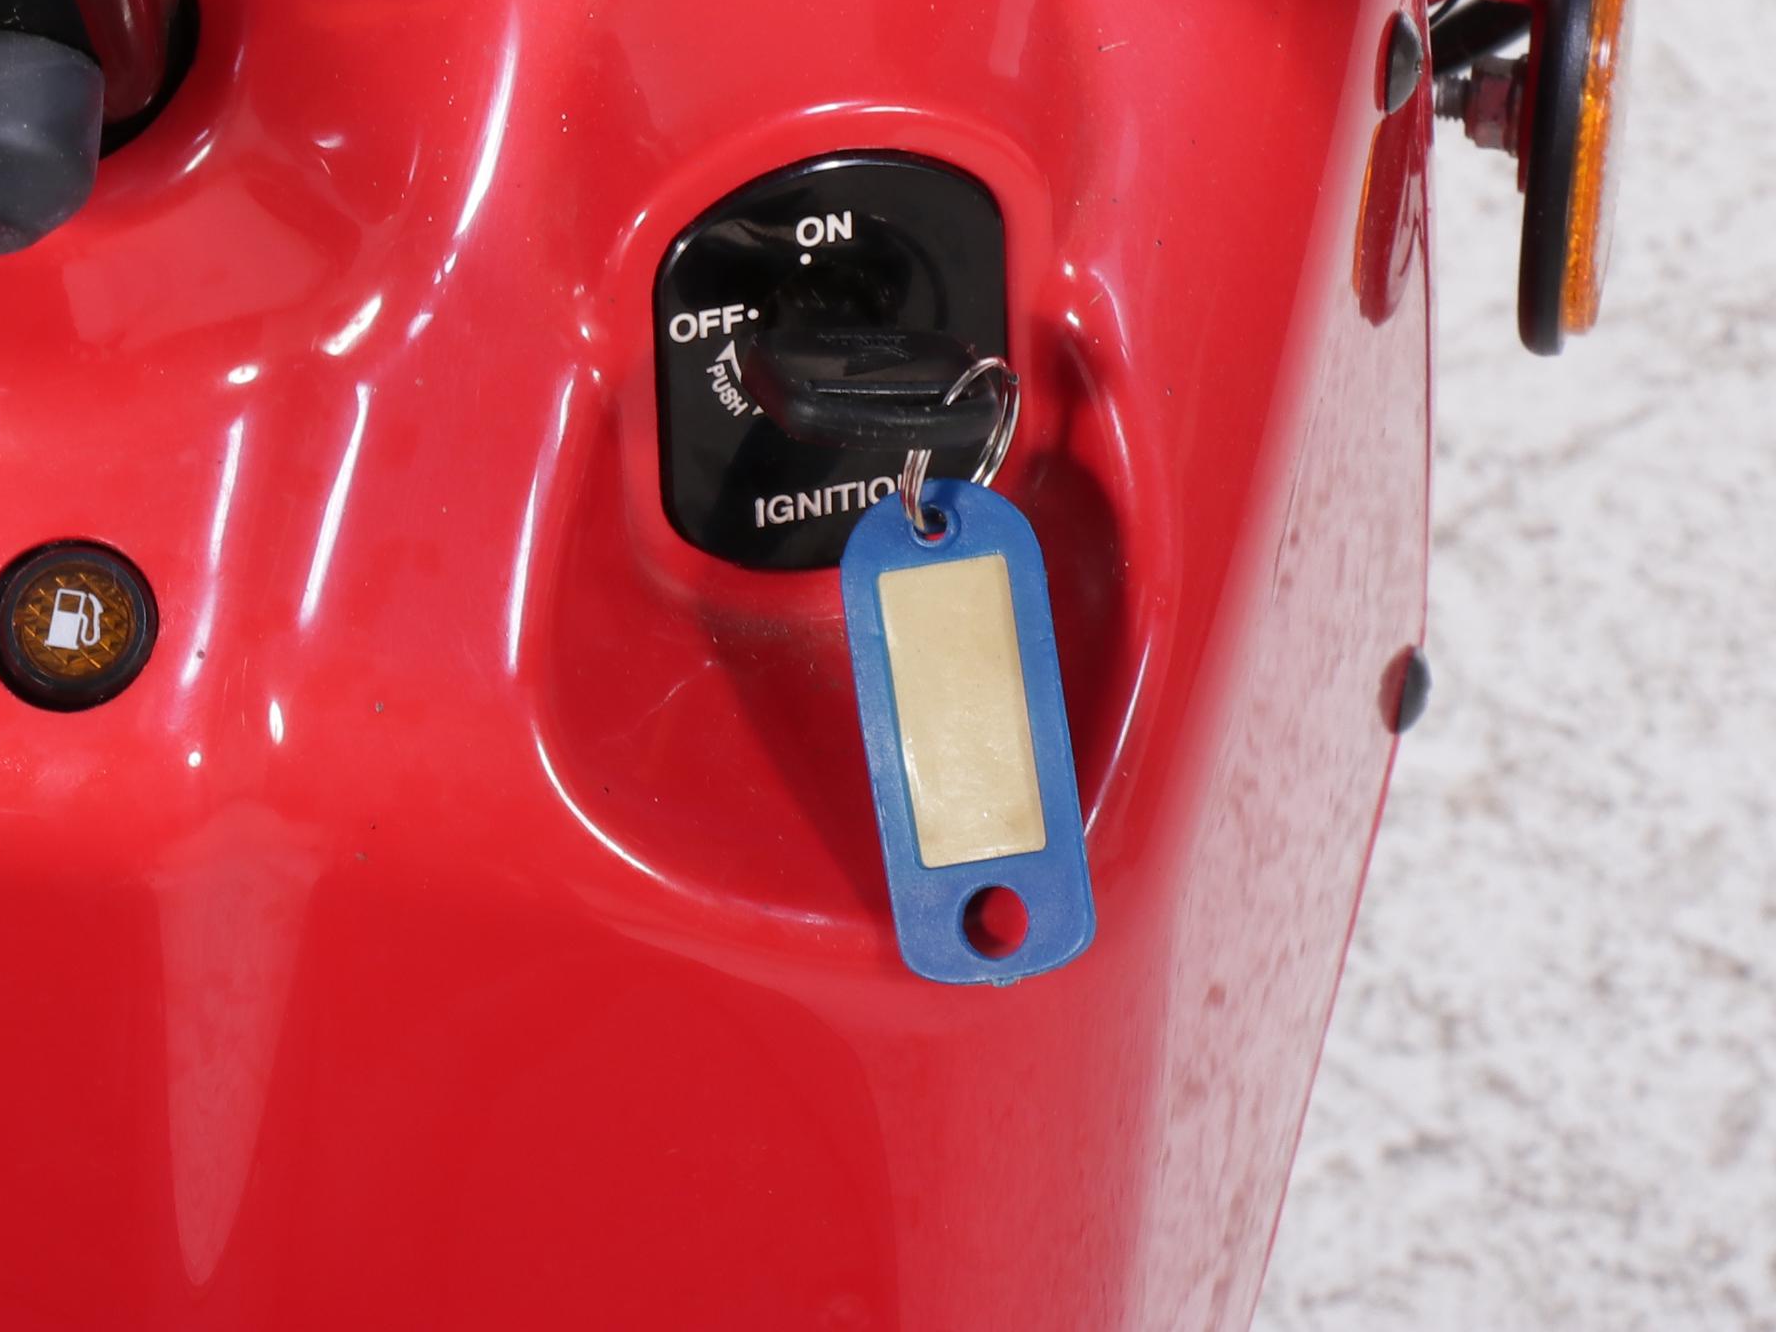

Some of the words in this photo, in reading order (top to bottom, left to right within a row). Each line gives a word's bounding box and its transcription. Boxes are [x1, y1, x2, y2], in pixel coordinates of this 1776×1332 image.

[795, 211, 854, 248] ON
[668, 303, 746, 344] OFF
[706, 363, 750, 417] PUSH
[754, 473, 903, 529] IGNITIO
